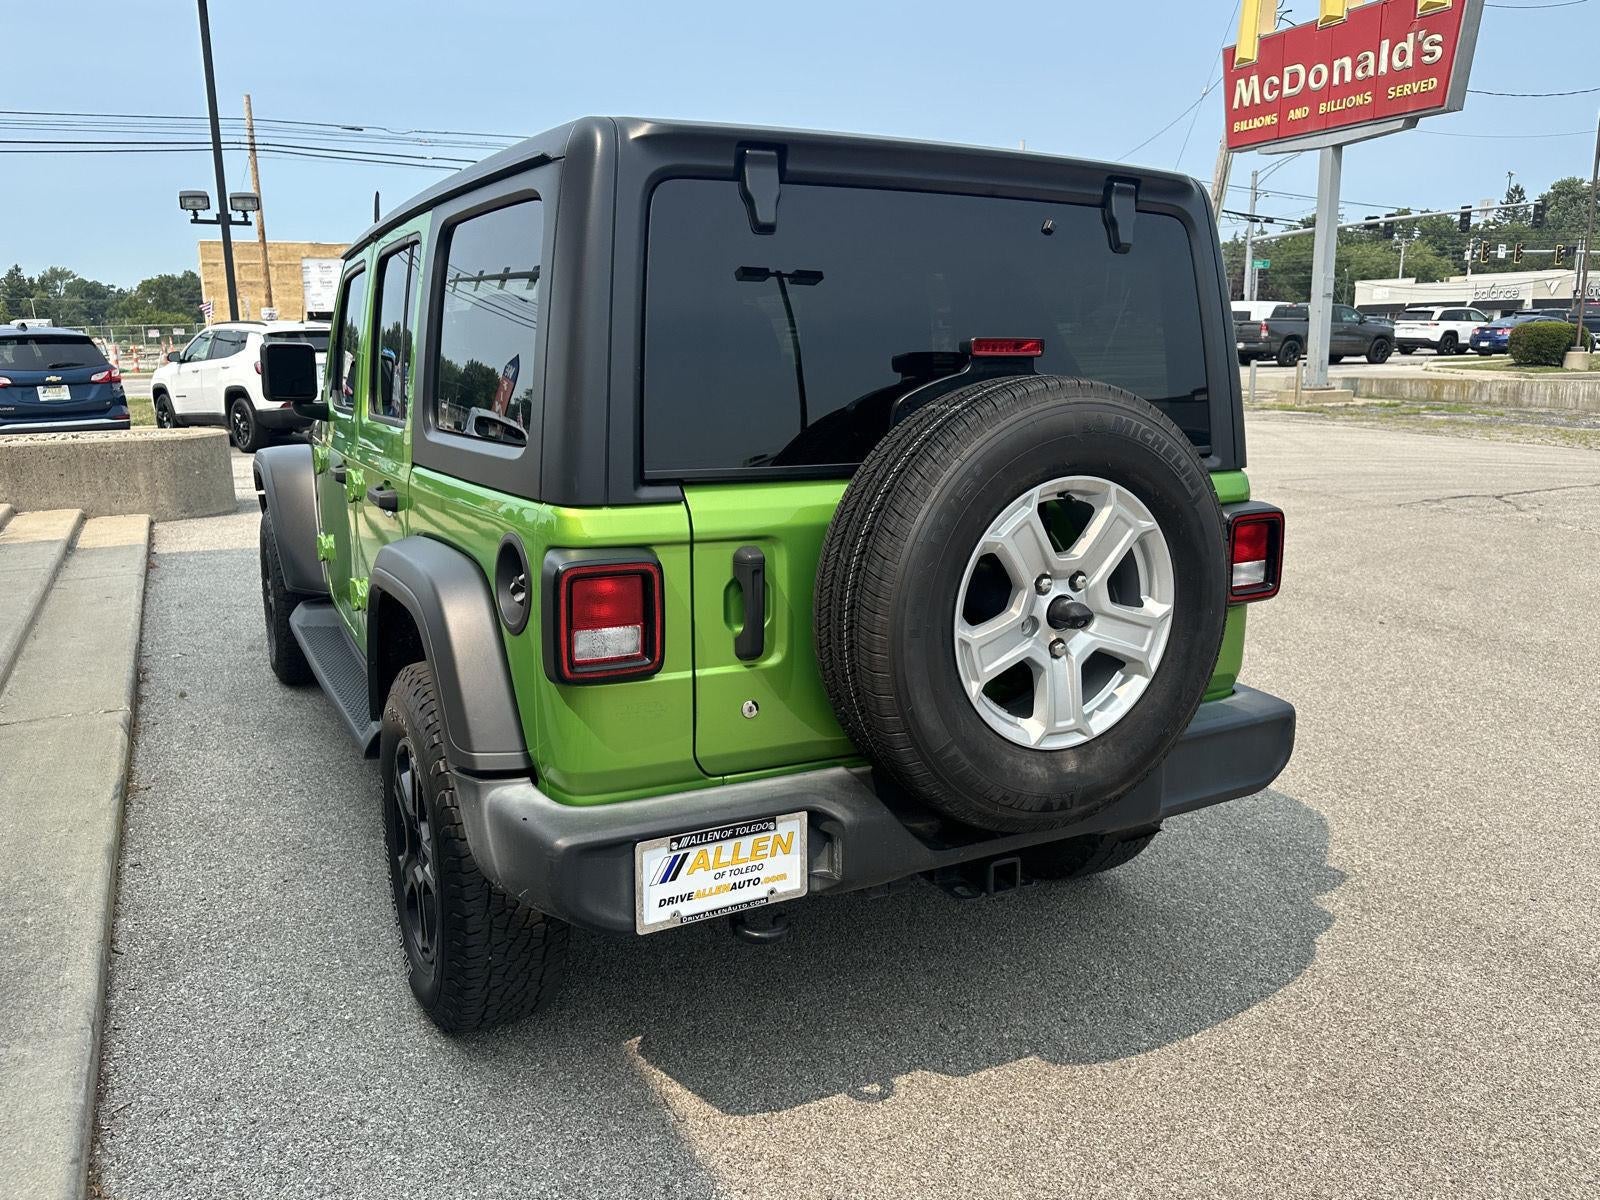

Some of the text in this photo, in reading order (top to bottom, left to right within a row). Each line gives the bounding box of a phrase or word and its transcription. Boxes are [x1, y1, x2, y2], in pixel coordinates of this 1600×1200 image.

[1232, 29, 1444, 110] McDonald's
[1233, 77, 1438, 133] BILLIONS AND BILLIONS SERVED
[1472, 282, 1520, 299] balance
[1111, 415, 1200, 500] MICHELIN
[686, 831, 795, 875] ALLEN
[688, 822, 769, 846] ALLEN OF TOLEDO
[658, 872, 788, 908] DRIVEALLENAUTO.com
[713, 863, 764, 881] OF TOLEDO
